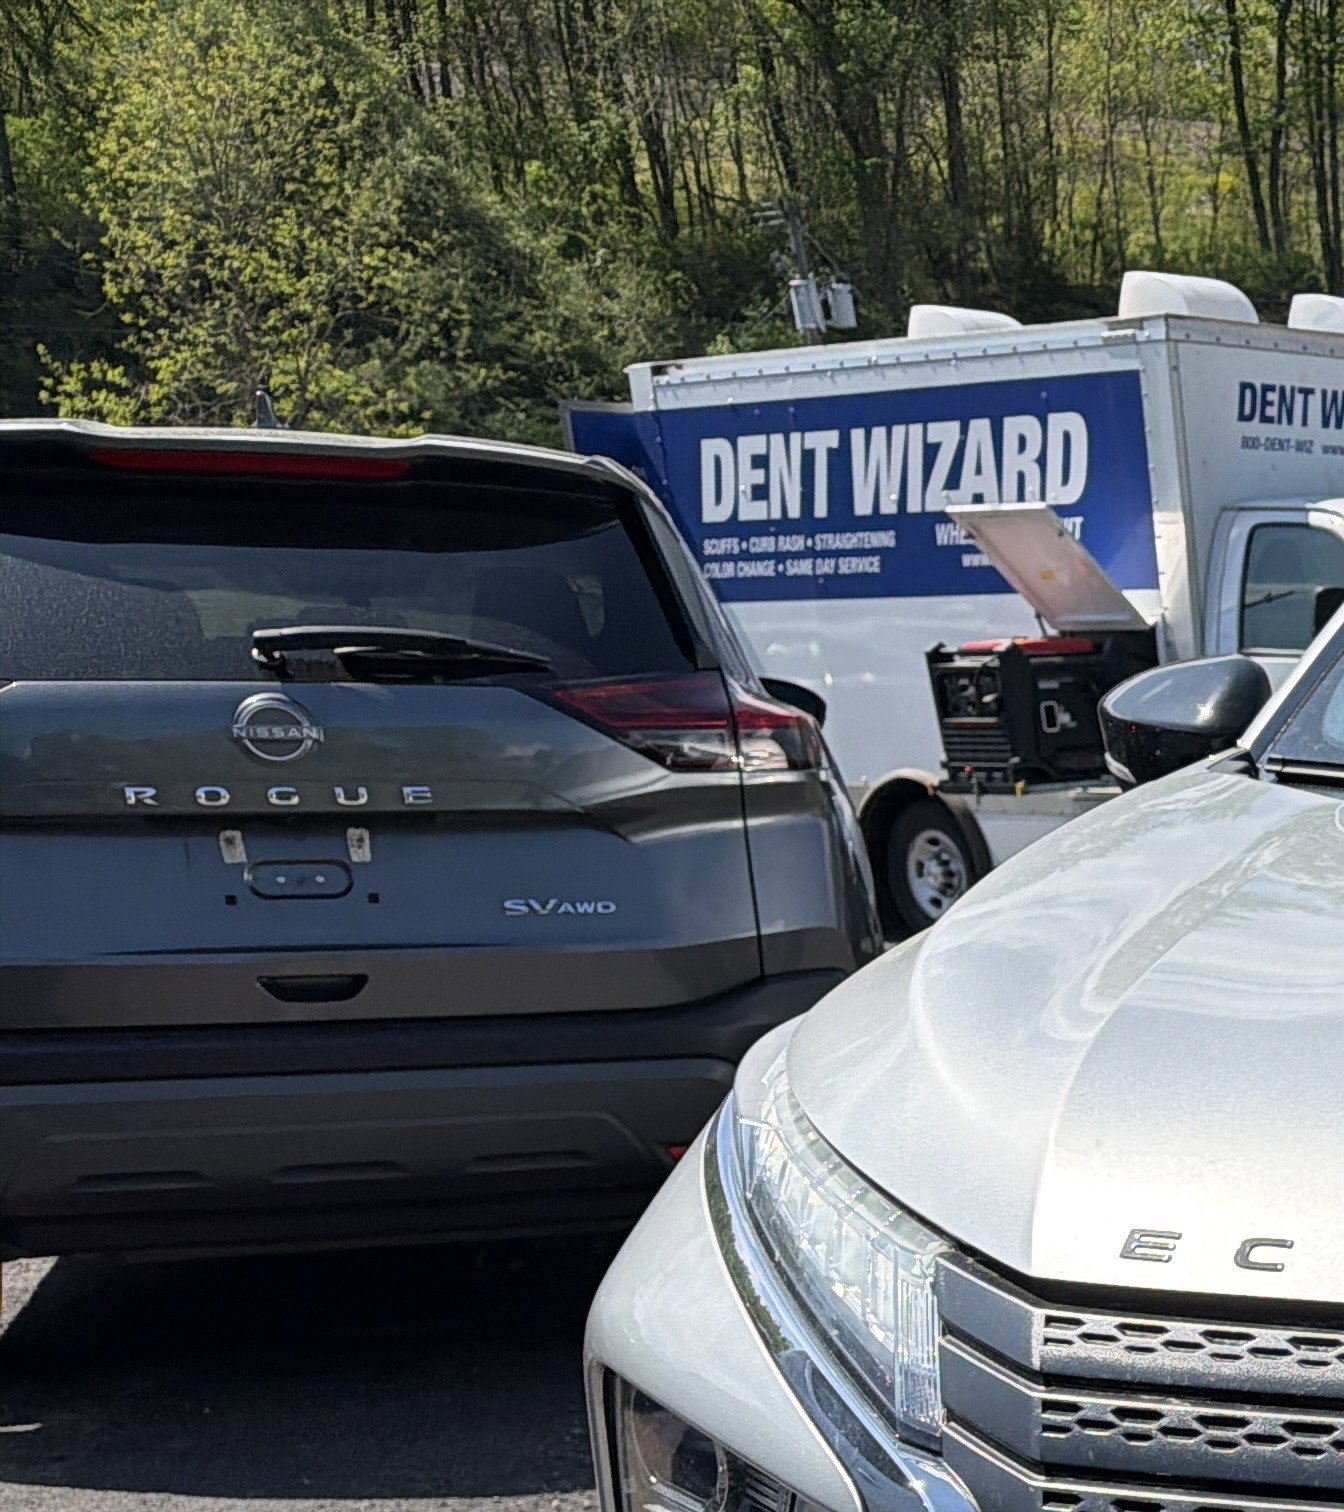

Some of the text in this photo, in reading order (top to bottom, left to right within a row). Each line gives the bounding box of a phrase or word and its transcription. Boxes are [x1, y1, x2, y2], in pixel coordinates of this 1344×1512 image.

[1237, 381, 1315, 427] DENT
[701, 412, 1088, 523] DENT WIZARD
[703, 530, 896, 556] SCUFFS CURB RASH STRAIGHTENING
[703, 555, 881, 579] COLOR CHANGE SAME DAY SERVICE
[232, 725, 324, 741] NISSAN
[124, 786, 433, 805] ROGUE
